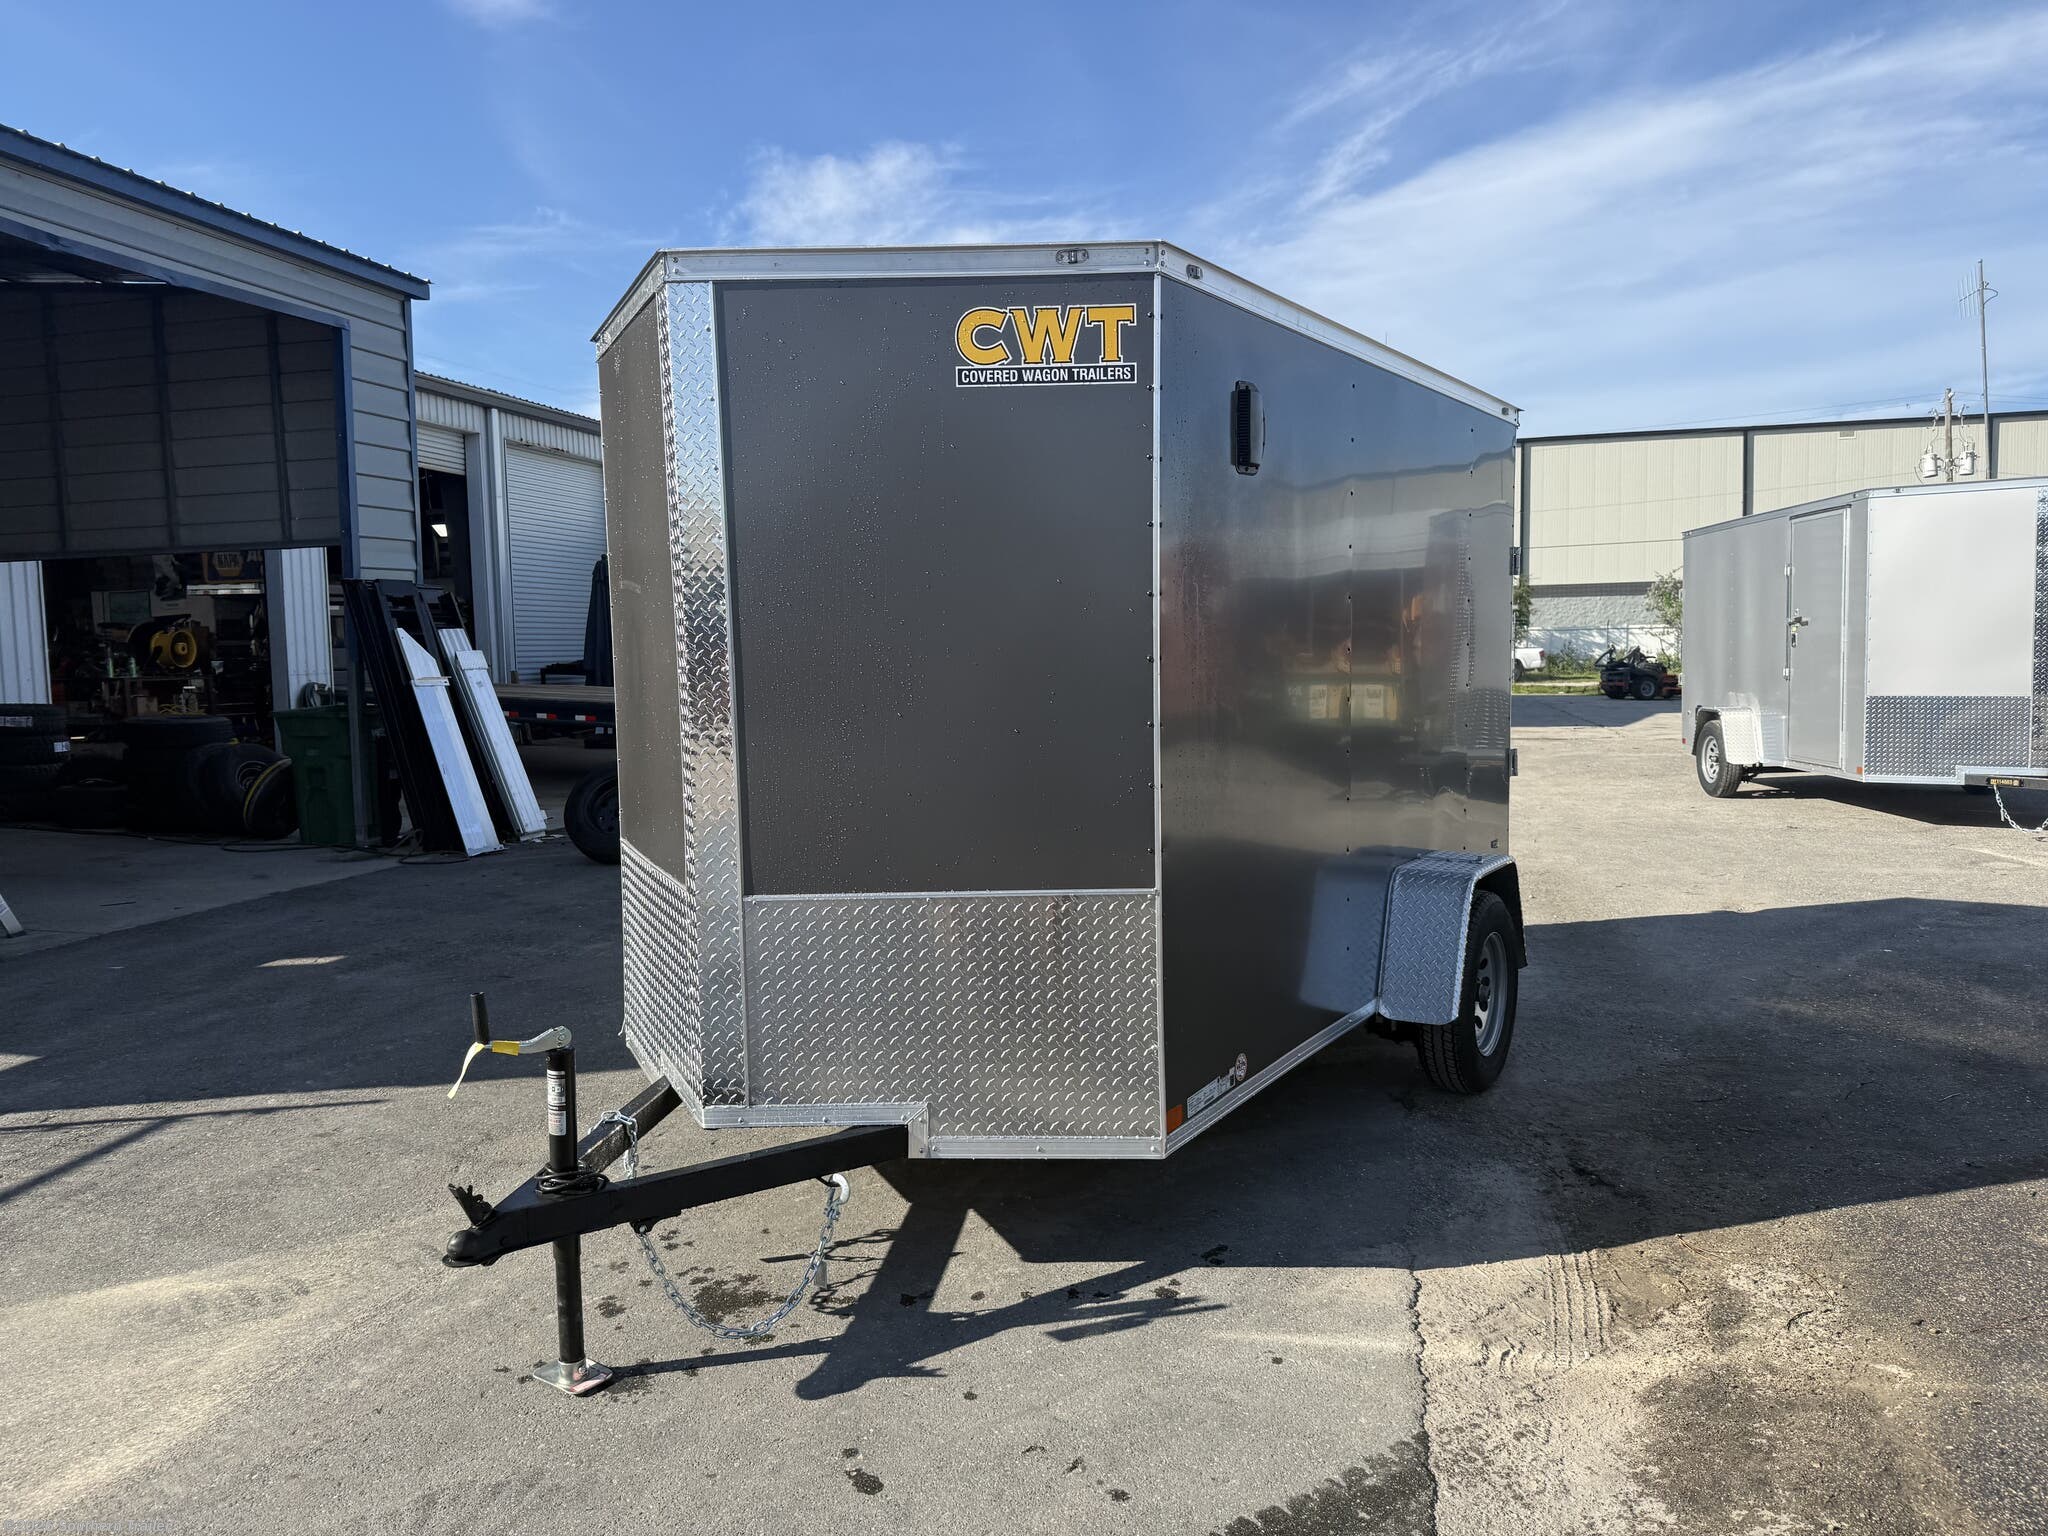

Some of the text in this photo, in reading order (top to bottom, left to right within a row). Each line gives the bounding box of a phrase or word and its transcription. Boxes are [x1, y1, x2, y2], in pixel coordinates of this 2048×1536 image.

[956, 304, 1136, 365] CWT
[961, 367, 1131, 384] COVERED WAGON TRAILERS
